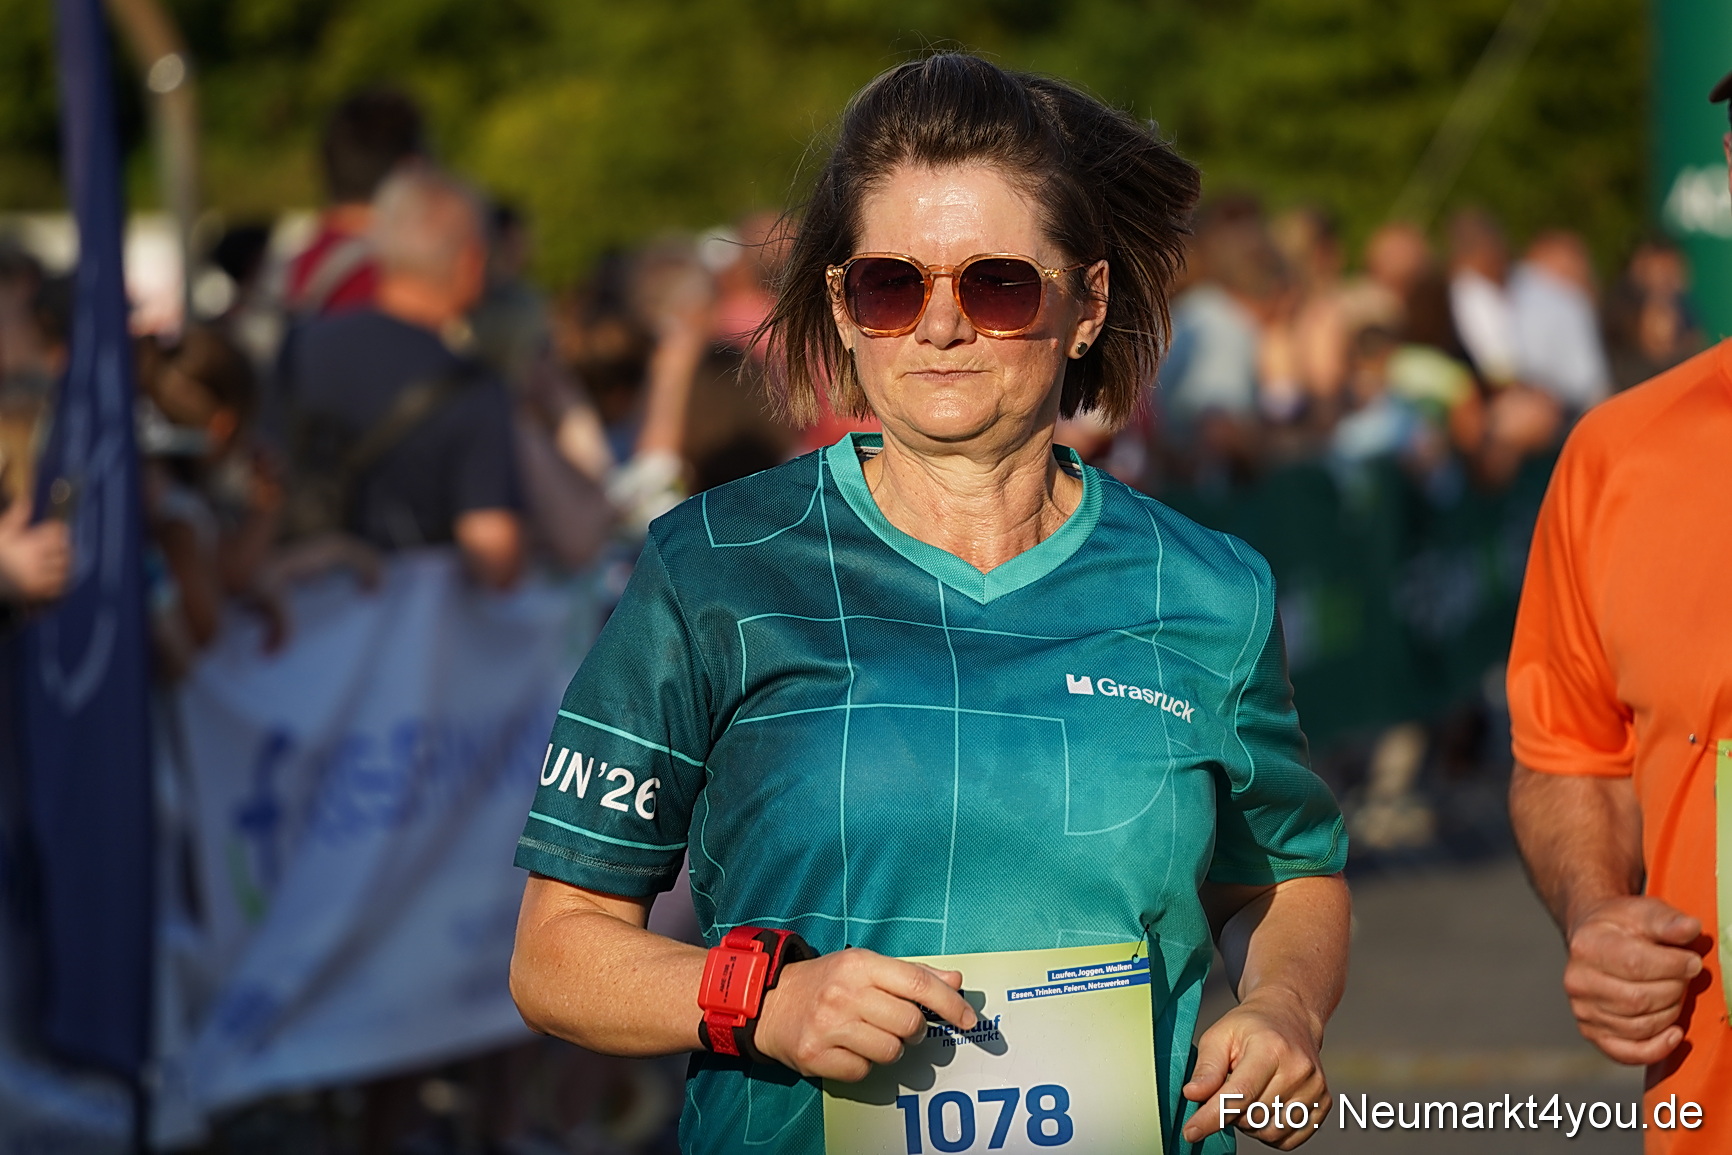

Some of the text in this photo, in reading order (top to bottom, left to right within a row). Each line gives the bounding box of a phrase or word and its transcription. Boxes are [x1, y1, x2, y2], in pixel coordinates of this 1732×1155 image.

[1097, 677, 1195, 723] Grasruck
[1051, 963, 1132, 980] Laufen, Joggen, Walken
[1011, 979, 1129, 1000] Essen, Trinken, Feiern, Netzwerken
[942, 1030, 1000, 1047] neumarkt
[896, 1084, 1074, 1155] 1078
